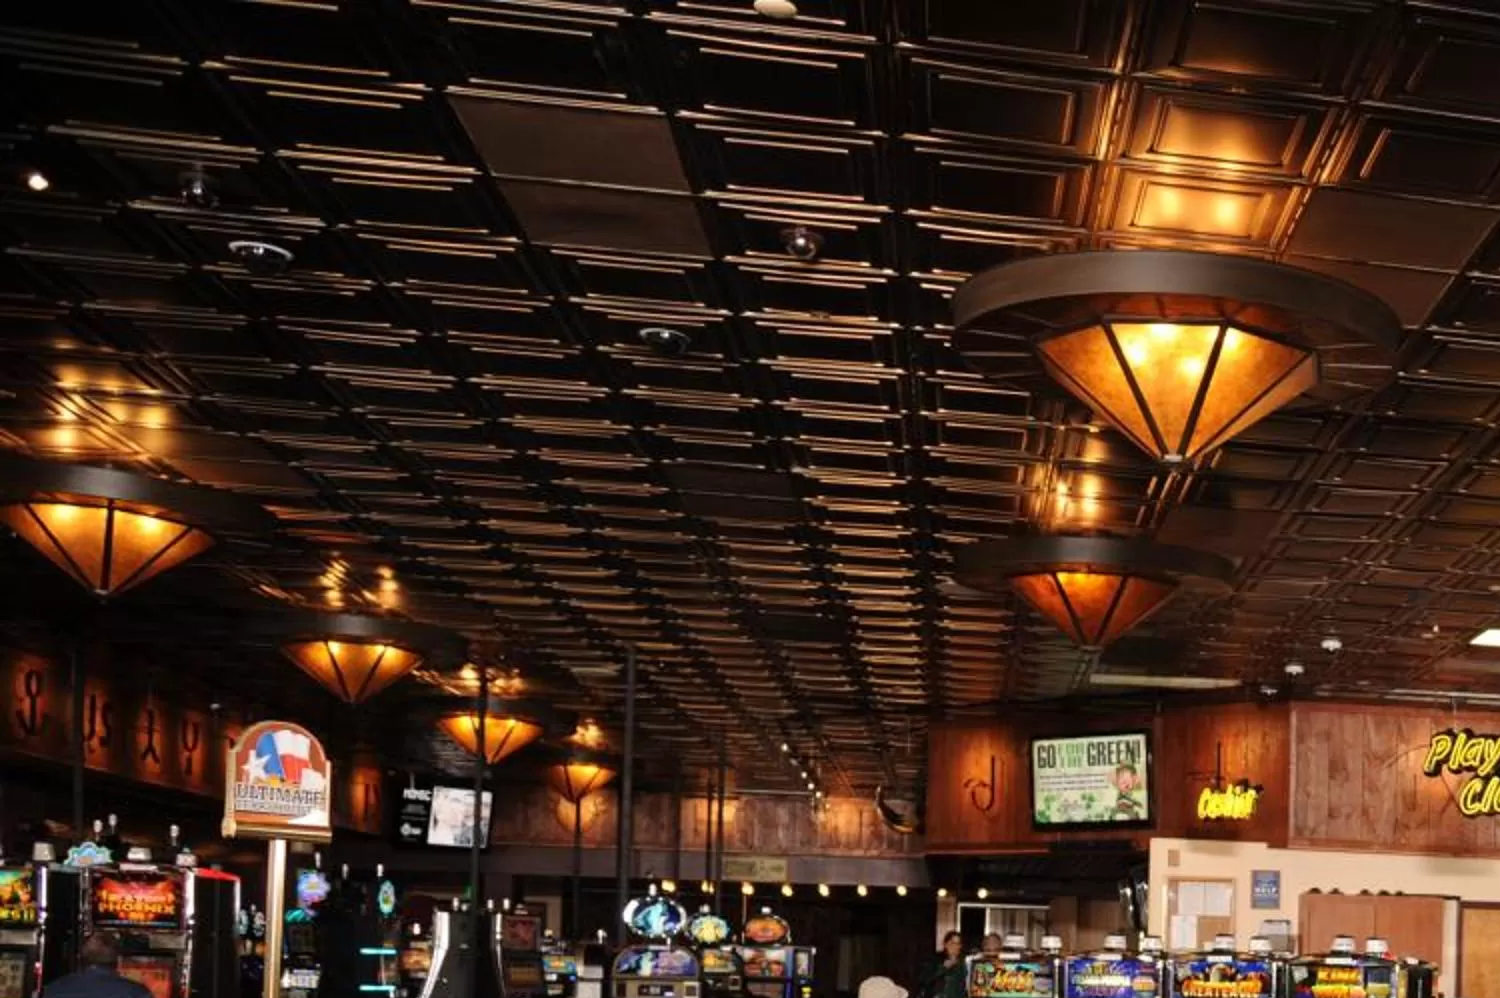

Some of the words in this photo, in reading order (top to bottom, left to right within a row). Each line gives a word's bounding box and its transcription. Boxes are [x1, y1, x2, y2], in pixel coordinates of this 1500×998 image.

[1037, 743, 1057, 769] GO
[1087, 739, 1141, 767] GREEN!
[235, 783, 321, 805] ULTIMATE
